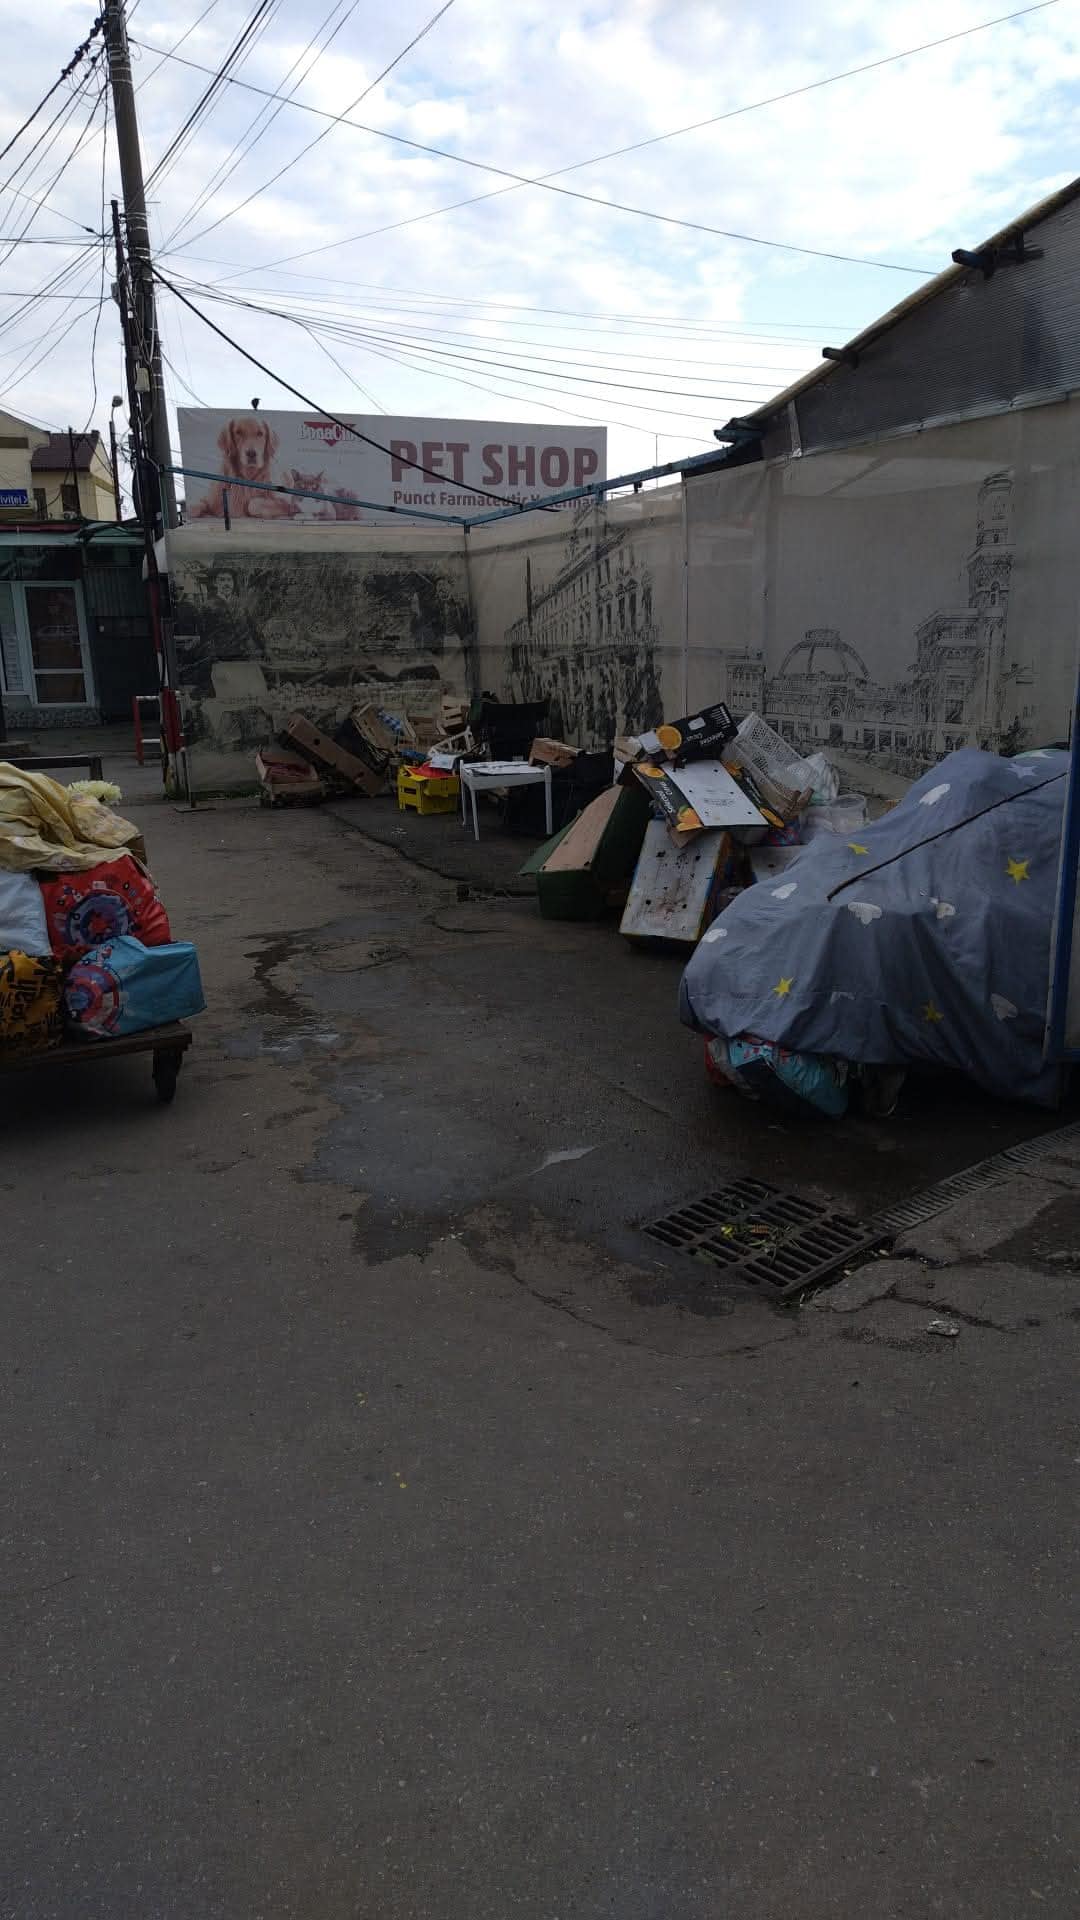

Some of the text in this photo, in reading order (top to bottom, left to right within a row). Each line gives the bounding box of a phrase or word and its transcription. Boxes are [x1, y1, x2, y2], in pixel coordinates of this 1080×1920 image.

[390, 440, 599, 488] PET SHOP
[393, 490, 436, 505] Punct
